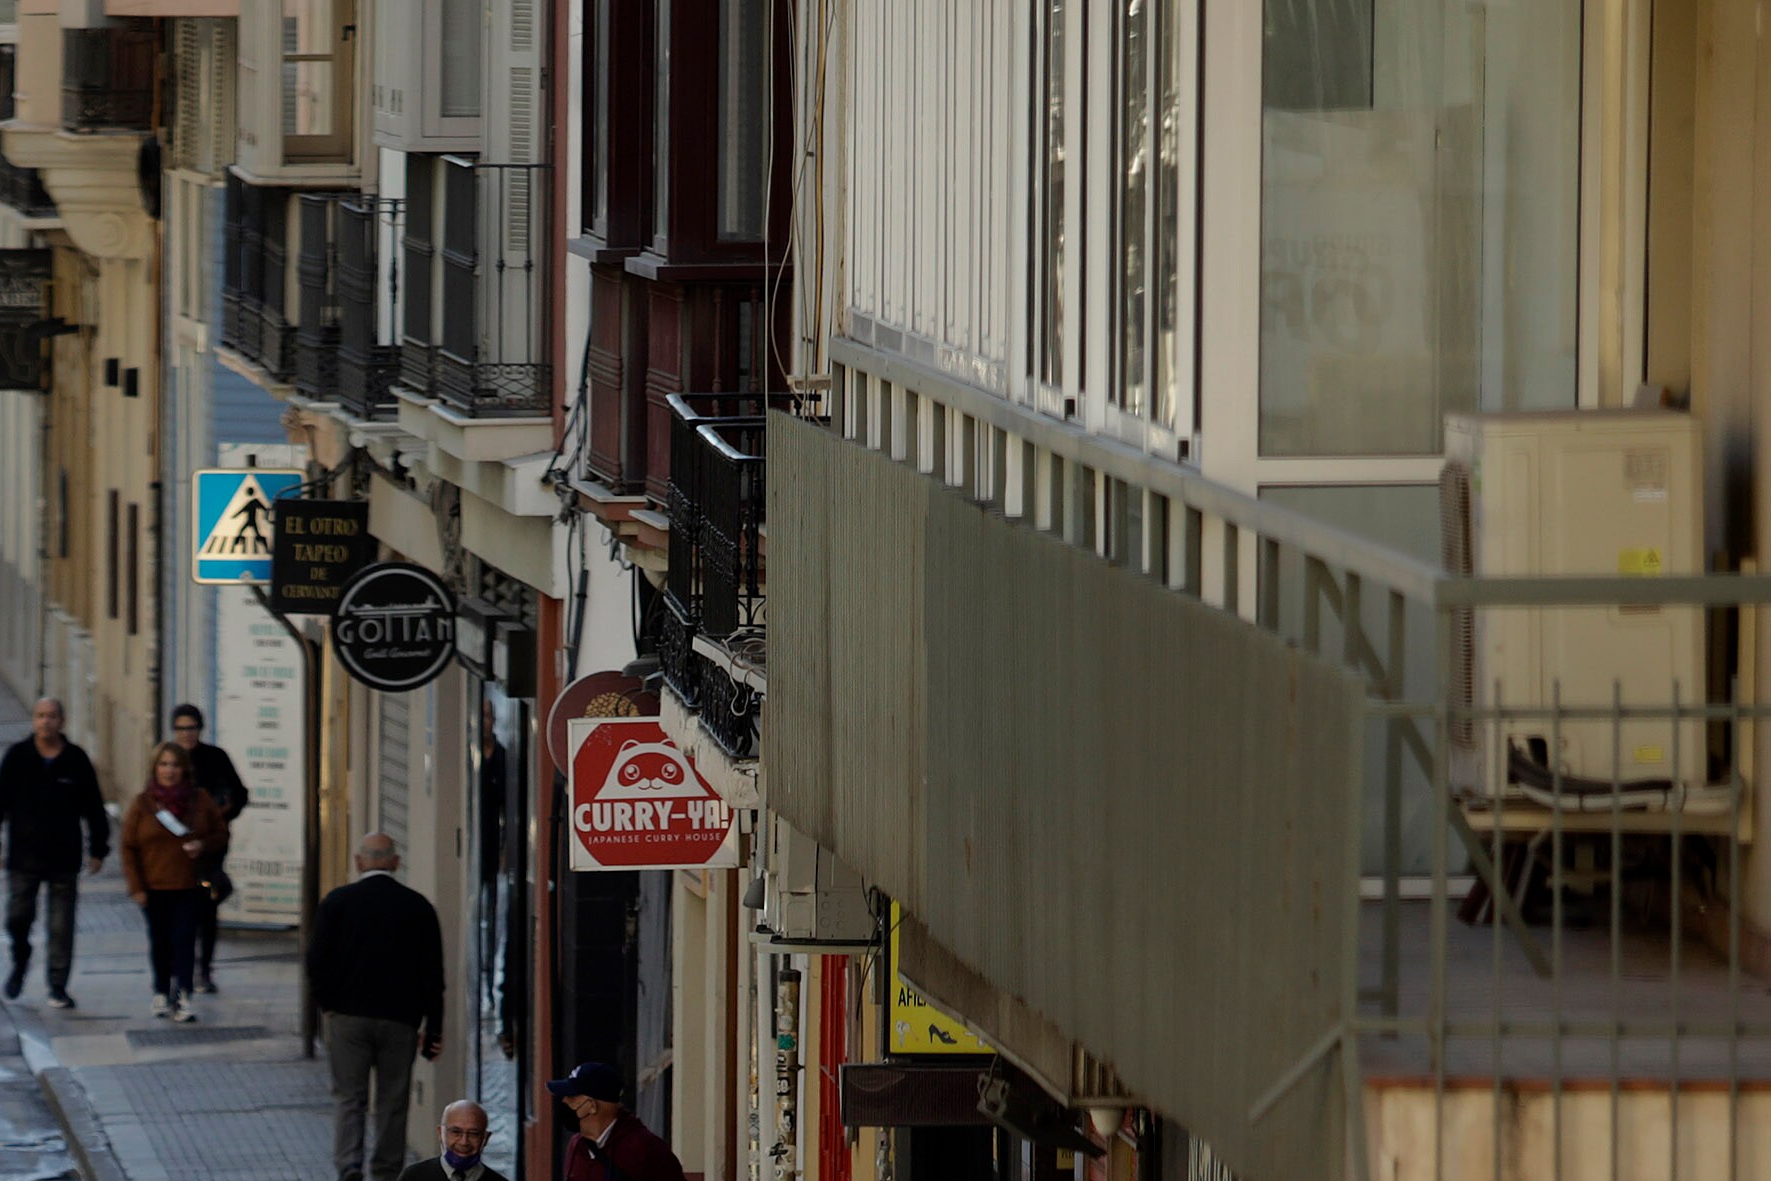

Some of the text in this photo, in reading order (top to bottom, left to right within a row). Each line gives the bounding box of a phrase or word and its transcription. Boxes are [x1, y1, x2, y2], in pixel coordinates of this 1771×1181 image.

[285, 517, 358, 536] EL OTRO
[293, 544, 348, 562] TAPEO
[310, 567, 327, 581] DE
[575, 800, 728, 832] CURRY-YA!
[589, 832, 720, 844] JAPANESE CURRY HOUSE
